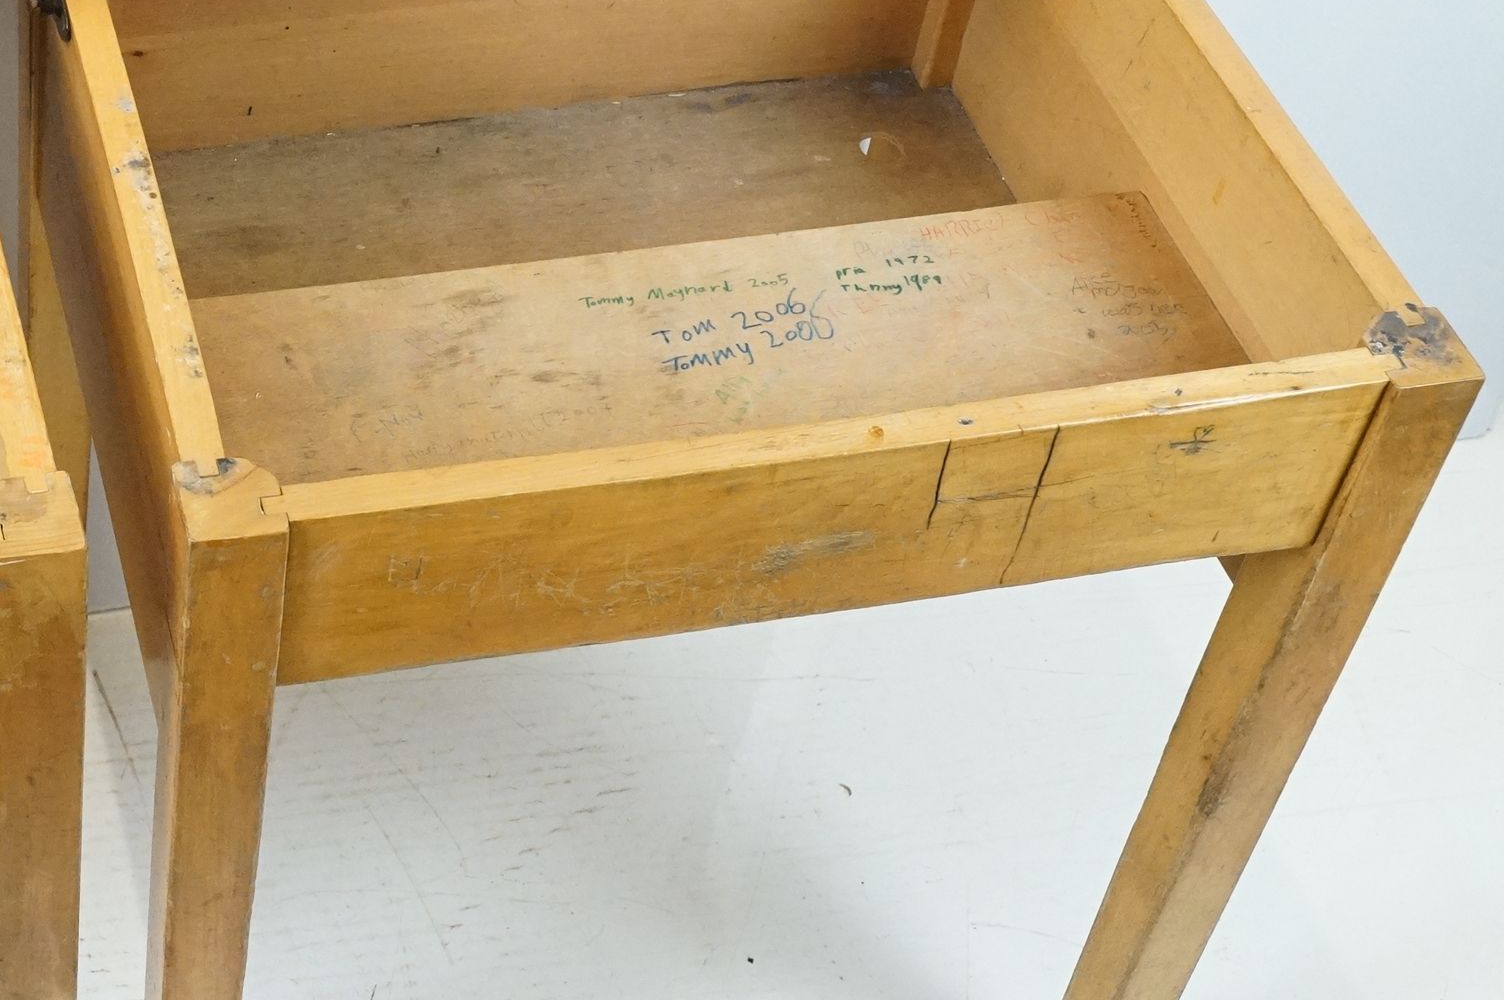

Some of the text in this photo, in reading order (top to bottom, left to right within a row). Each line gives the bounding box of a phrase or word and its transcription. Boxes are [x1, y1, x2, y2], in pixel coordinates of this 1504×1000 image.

[885, 255, 934, 267] 1972
[578, 273, 789, 308] Tommy Maynard 2005
[651, 318, 716, 344] Tom
[731, 287, 806, 329] 2006
[662, 341, 755, 372] Tommy
